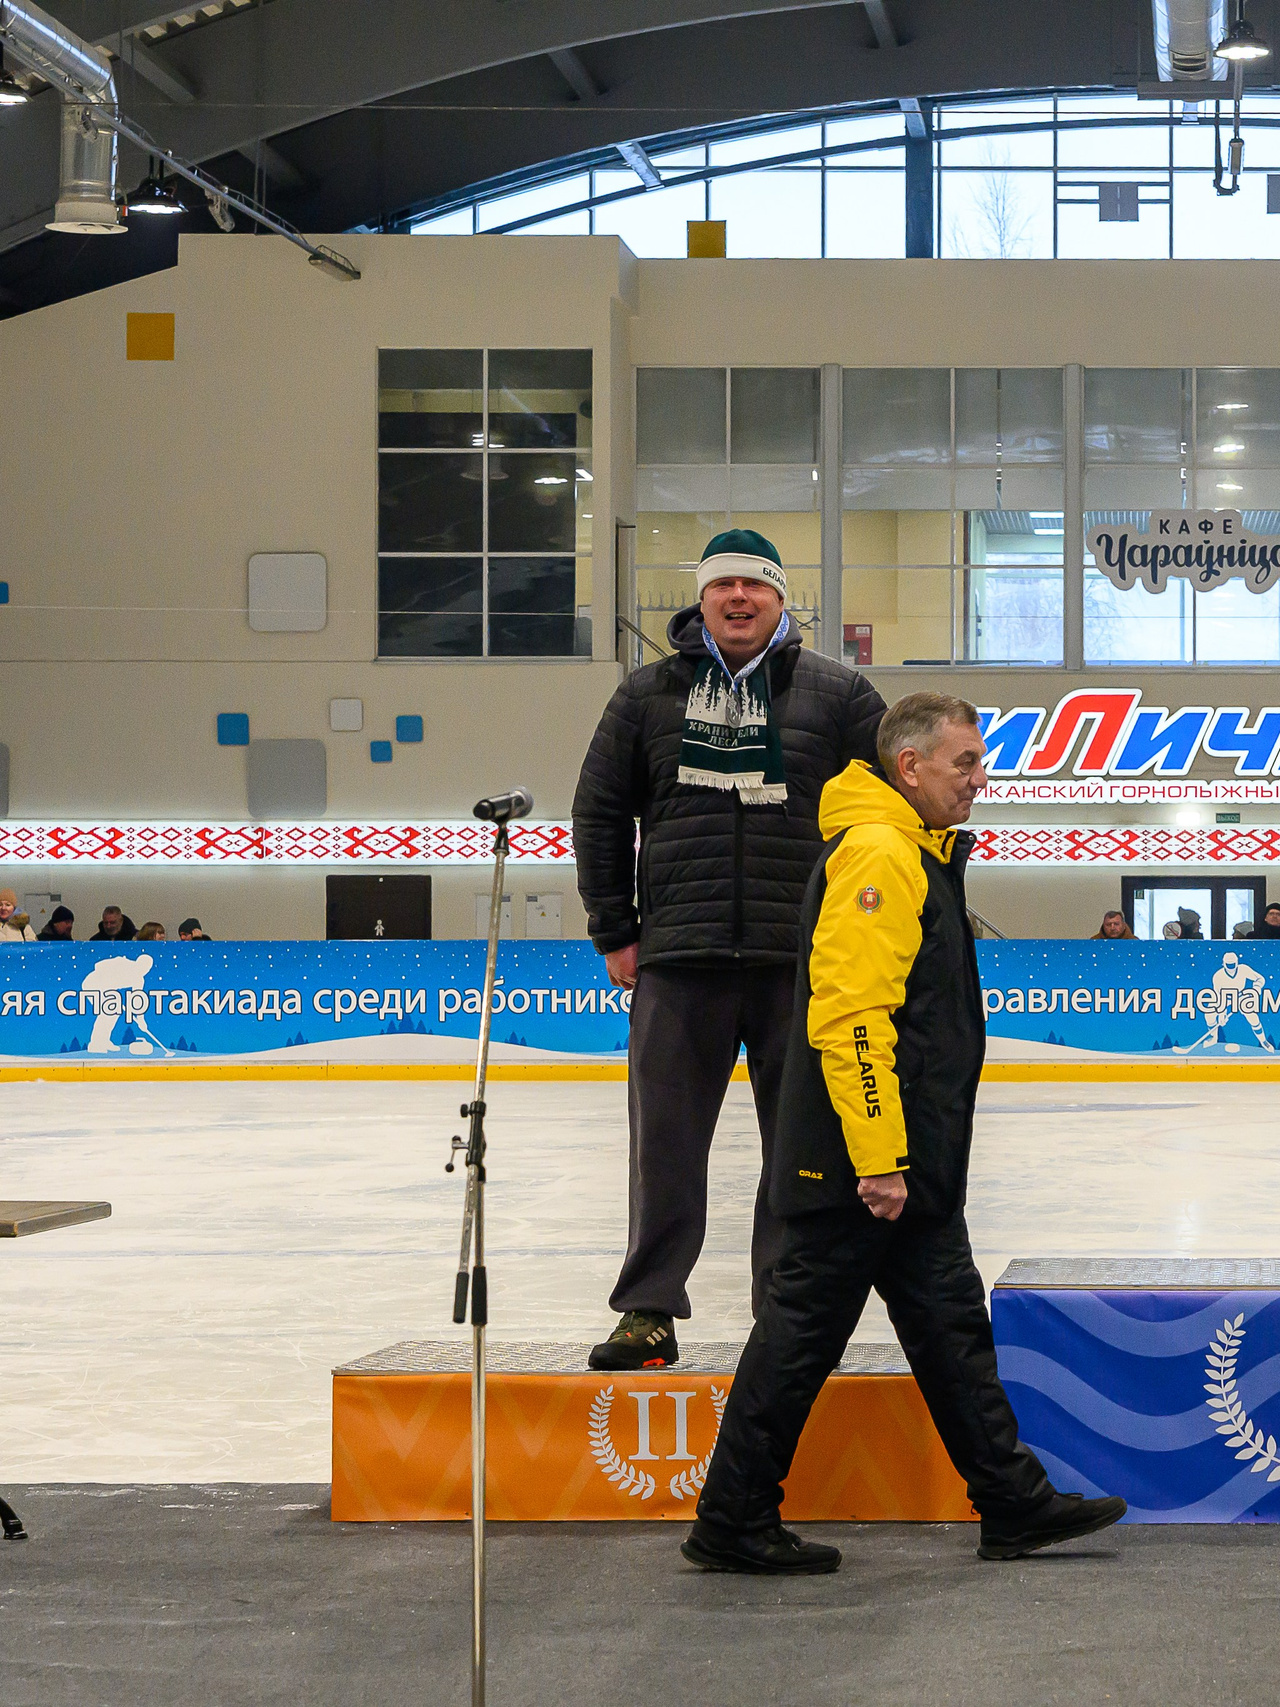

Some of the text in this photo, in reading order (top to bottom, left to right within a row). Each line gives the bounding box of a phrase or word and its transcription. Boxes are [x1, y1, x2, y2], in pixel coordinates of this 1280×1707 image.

[1159, 519, 1233, 534] КАФЕ
[688, 721, 759, 738] ХРАНИТЕЛИ
[708, 735, 739, 747] ЛЕСА
[57, 988, 301, 1023] спартакиада
[312, 988, 428, 1022] среди
[853, 1025, 882, 1119] BELARUS
[798, 1169, 823, 1180] ORAZ
[627, 1391, 697, 1460] II
